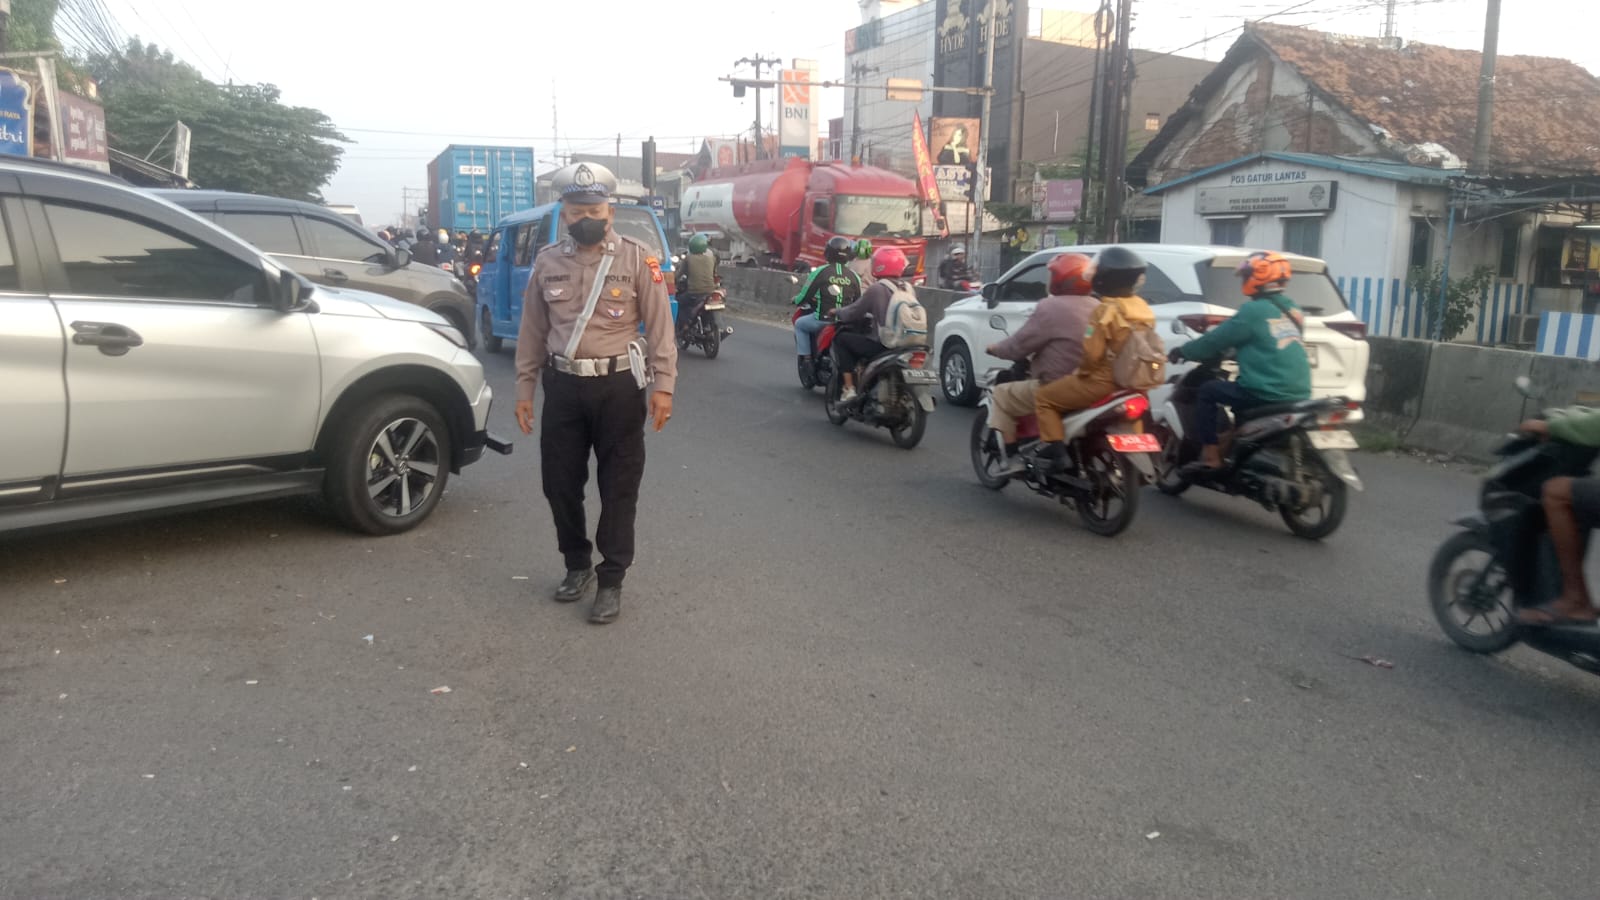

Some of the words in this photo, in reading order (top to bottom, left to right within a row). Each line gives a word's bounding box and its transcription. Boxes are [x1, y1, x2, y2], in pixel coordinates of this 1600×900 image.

[980, 19, 1009, 43] HDE
[940, 33, 965, 54] HYDE
[785, 106, 808, 120] BNI
[1230, 174, 1245, 184] POS
[1247, 172, 1273, 183] GATUR
[1274, 170, 1307, 181] LANTAS
[605, 274, 631, 283] POLRI
[829, 276, 851, 285] Grab
